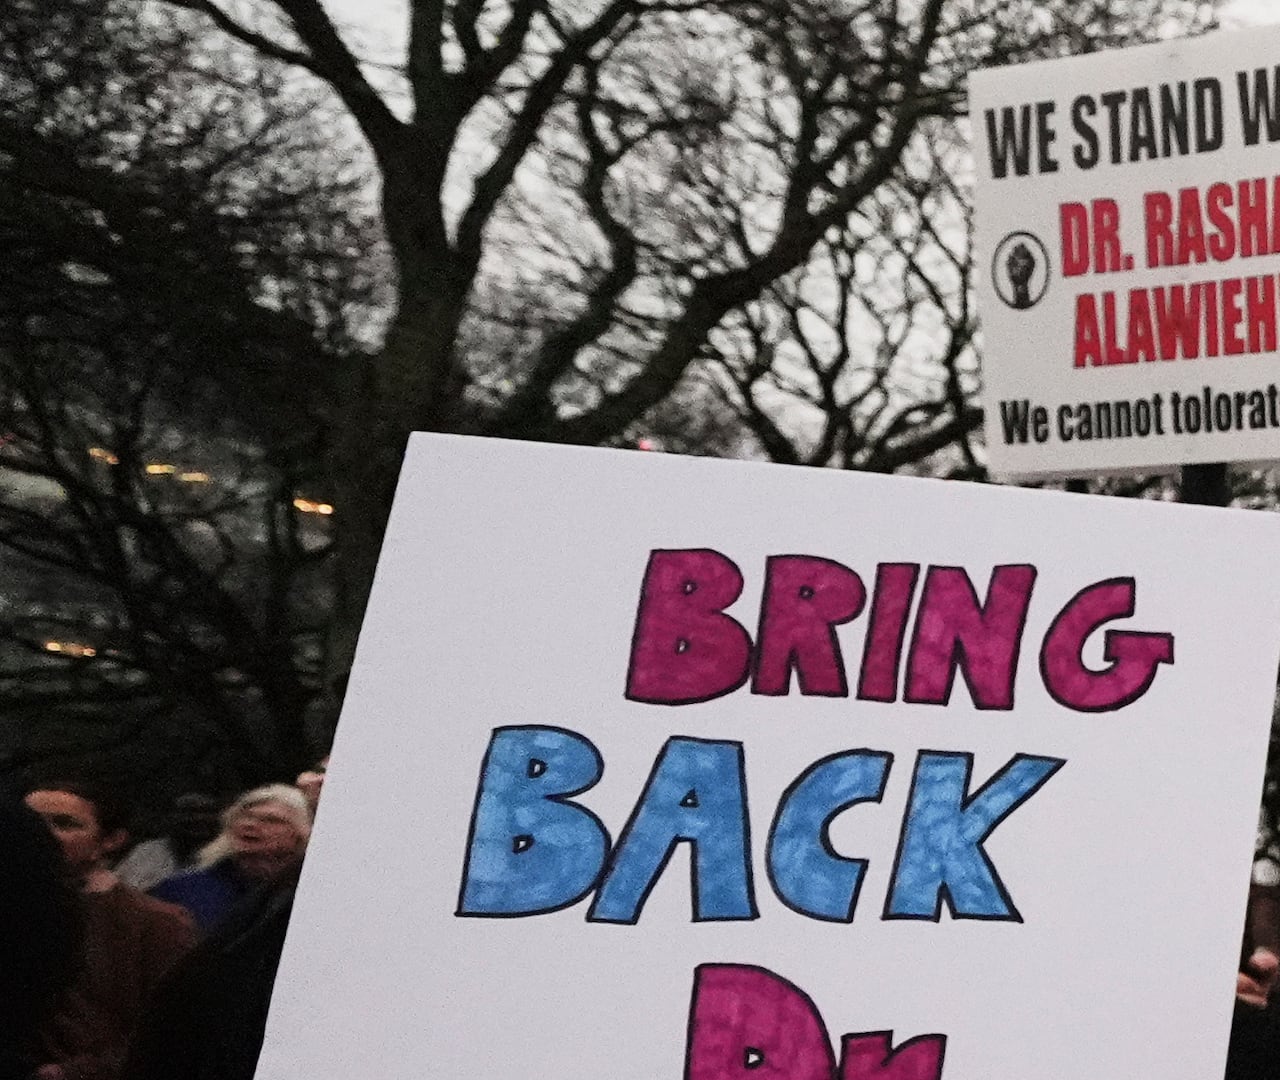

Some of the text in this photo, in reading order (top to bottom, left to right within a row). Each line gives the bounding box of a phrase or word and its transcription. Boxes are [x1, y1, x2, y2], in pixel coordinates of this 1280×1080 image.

[985, 101, 1059, 179] WE
[1071, 77, 1224, 170] STAND
[1059, 198, 1134, 278] DR.
[1000, 398, 1050, 446] We
[1057, 390, 1166, 442] cannot
[624, 549, 1175, 712] BRING
[455, 725, 1067, 924] BACK
